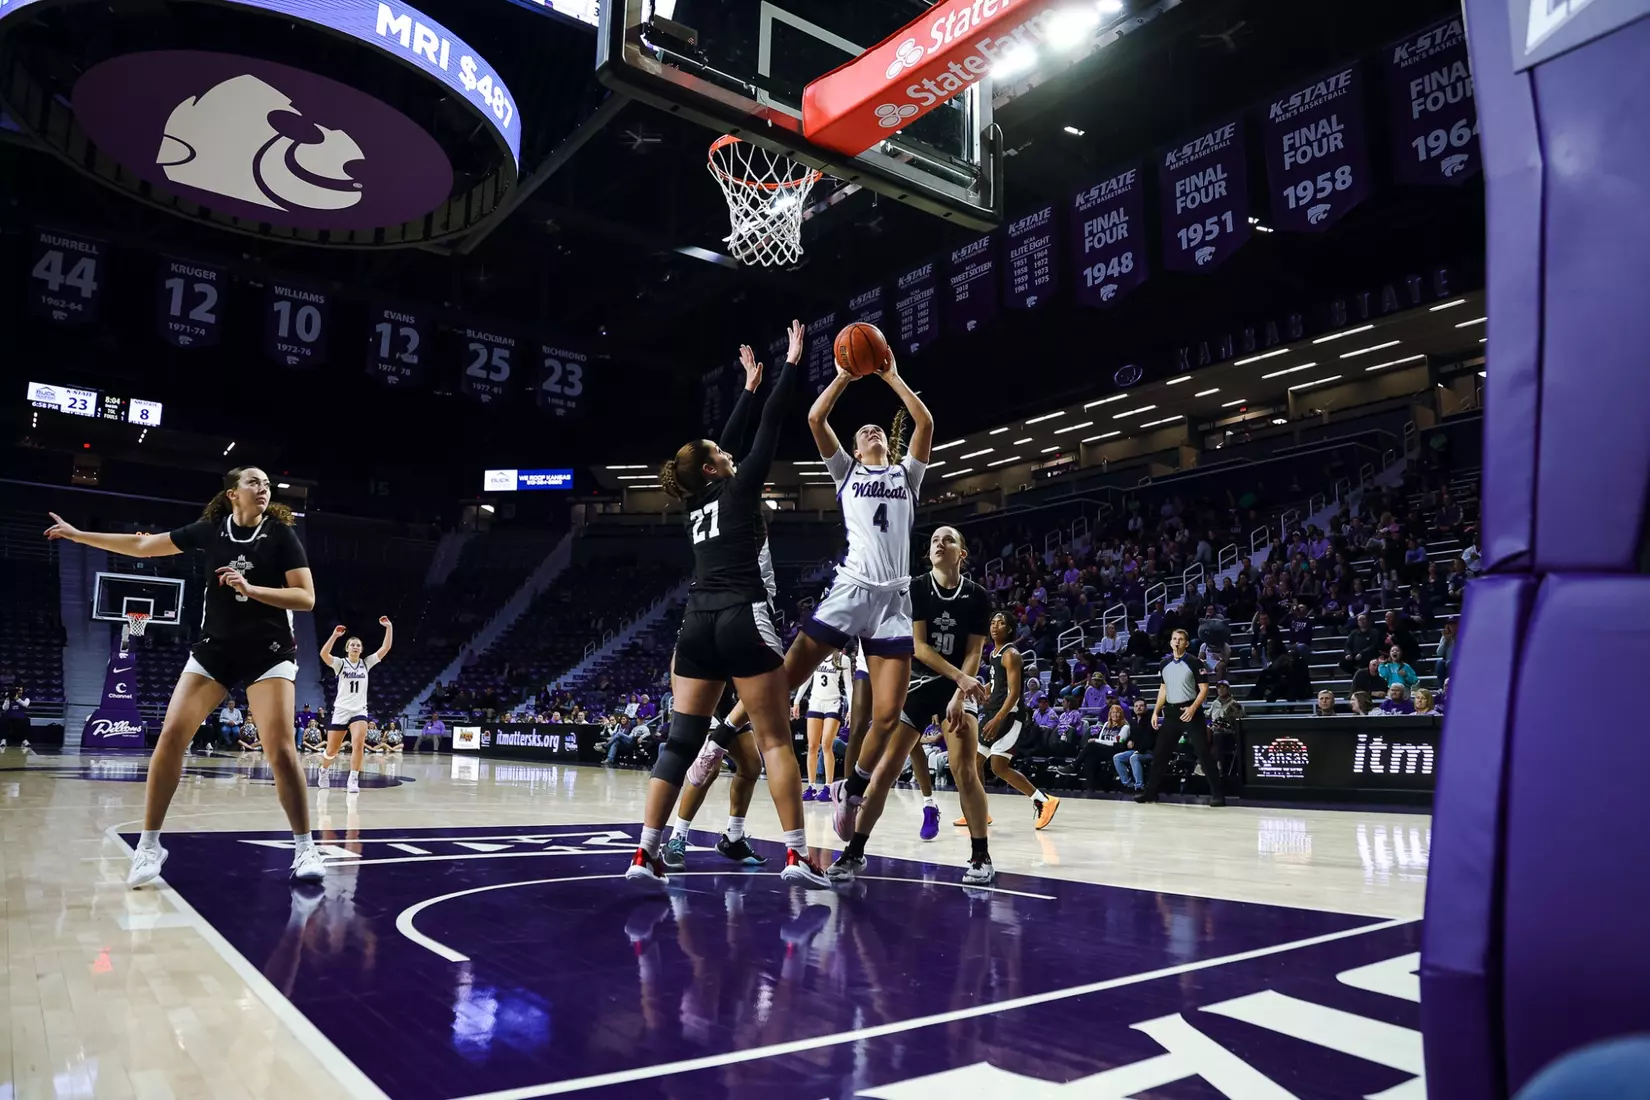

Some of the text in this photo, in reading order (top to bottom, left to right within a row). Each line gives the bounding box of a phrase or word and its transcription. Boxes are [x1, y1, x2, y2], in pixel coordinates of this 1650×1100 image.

[928, 0, 1011, 56] State
[1393, 19, 1463, 64] K-STA
[1400, 37, 1464, 68] MEN'S BASKET
[376, 1, 513, 129] MRI $487
[1409, 60, 1469, 100] FINA
[1269, 69, 1352, 119] K-STATE
[1275, 88, 1347, 124] MEN'S BASKETBALL
[1165, 122, 1236, 166] K-STATE
[1282, 114, 1344, 153] FINAL
[1170, 139, 1230, 170] MEN'S BASKETBALL
[1283, 132, 1344, 171] FOUR
[1075, 168, 1136, 207] K-STATE
[1175, 163, 1228, 198] FINAL
[1283, 164, 1353, 209] 1958
[1079, 184, 1132, 212] MEN'S BASKETBALL
[1176, 180, 1228, 215] FOUR
[1008, 206, 1051, 235] K-STATE
[1084, 207, 1129, 238] FINAL
[1177, 210, 1233, 250] 1951
[40, 233, 99, 255] MURRELL
[952, 236, 990, 261] K-STATE
[1010, 235, 1050, 259] ELITE EIGHT
[1024, 236, 1036, 244] NCAA
[1084, 222, 1129, 254] FOUR
[1013, 257, 1028, 268] 1951
[1033, 248, 1048, 260] 1964
[1034, 257, 1048, 269] 1972
[32, 249, 98, 299] 44
[170, 262, 217, 281] KRUGER
[898, 263, 933, 287] K-STATE
[950, 260, 992, 285] SWEET SIXTEEN
[1014, 274, 1029, 285] 1959
[1034, 266, 1049, 277] 1973
[1034, 275, 1050, 286] 1975
[1083, 251, 1134, 287] 1948
[165, 277, 218, 324] 12
[274, 285, 325, 304] WILLIAMS
[1014, 283, 1028, 294] 1961
[1330, 267, 1449, 327] STATE
[41, 295, 83, 312] 1962-64
[383, 309, 415, 324] EVANS
[168, 322, 206, 336] 1971-74
[273, 300, 322, 343] 10
[276, 342, 312, 356] 1972-76
[375, 321, 420, 364] 12
[466, 328, 515, 347] BLACKMAN
[466, 342, 510, 382] 25
[542, 345, 587, 362] RICHMOND
[542, 358, 583, 397] 23
[68, 397, 87, 410] 23
[105, 396, 120, 405] 8:04
[140, 409, 149, 420] 8
[852, 481, 907, 500] Wildcats
[690, 500, 720, 545] 27
[872, 502, 889, 533] 4
[931, 632, 955, 655] 30
[350, 680, 359, 693] 11
[821, 674, 828, 687] 3
[91, 719, 142, 737] Dillons
[496, 728, 560, 752] itmattersks.org
[1252, 745, 1309, 767] Kansas
[1353, 734, 1434, 773] itm
